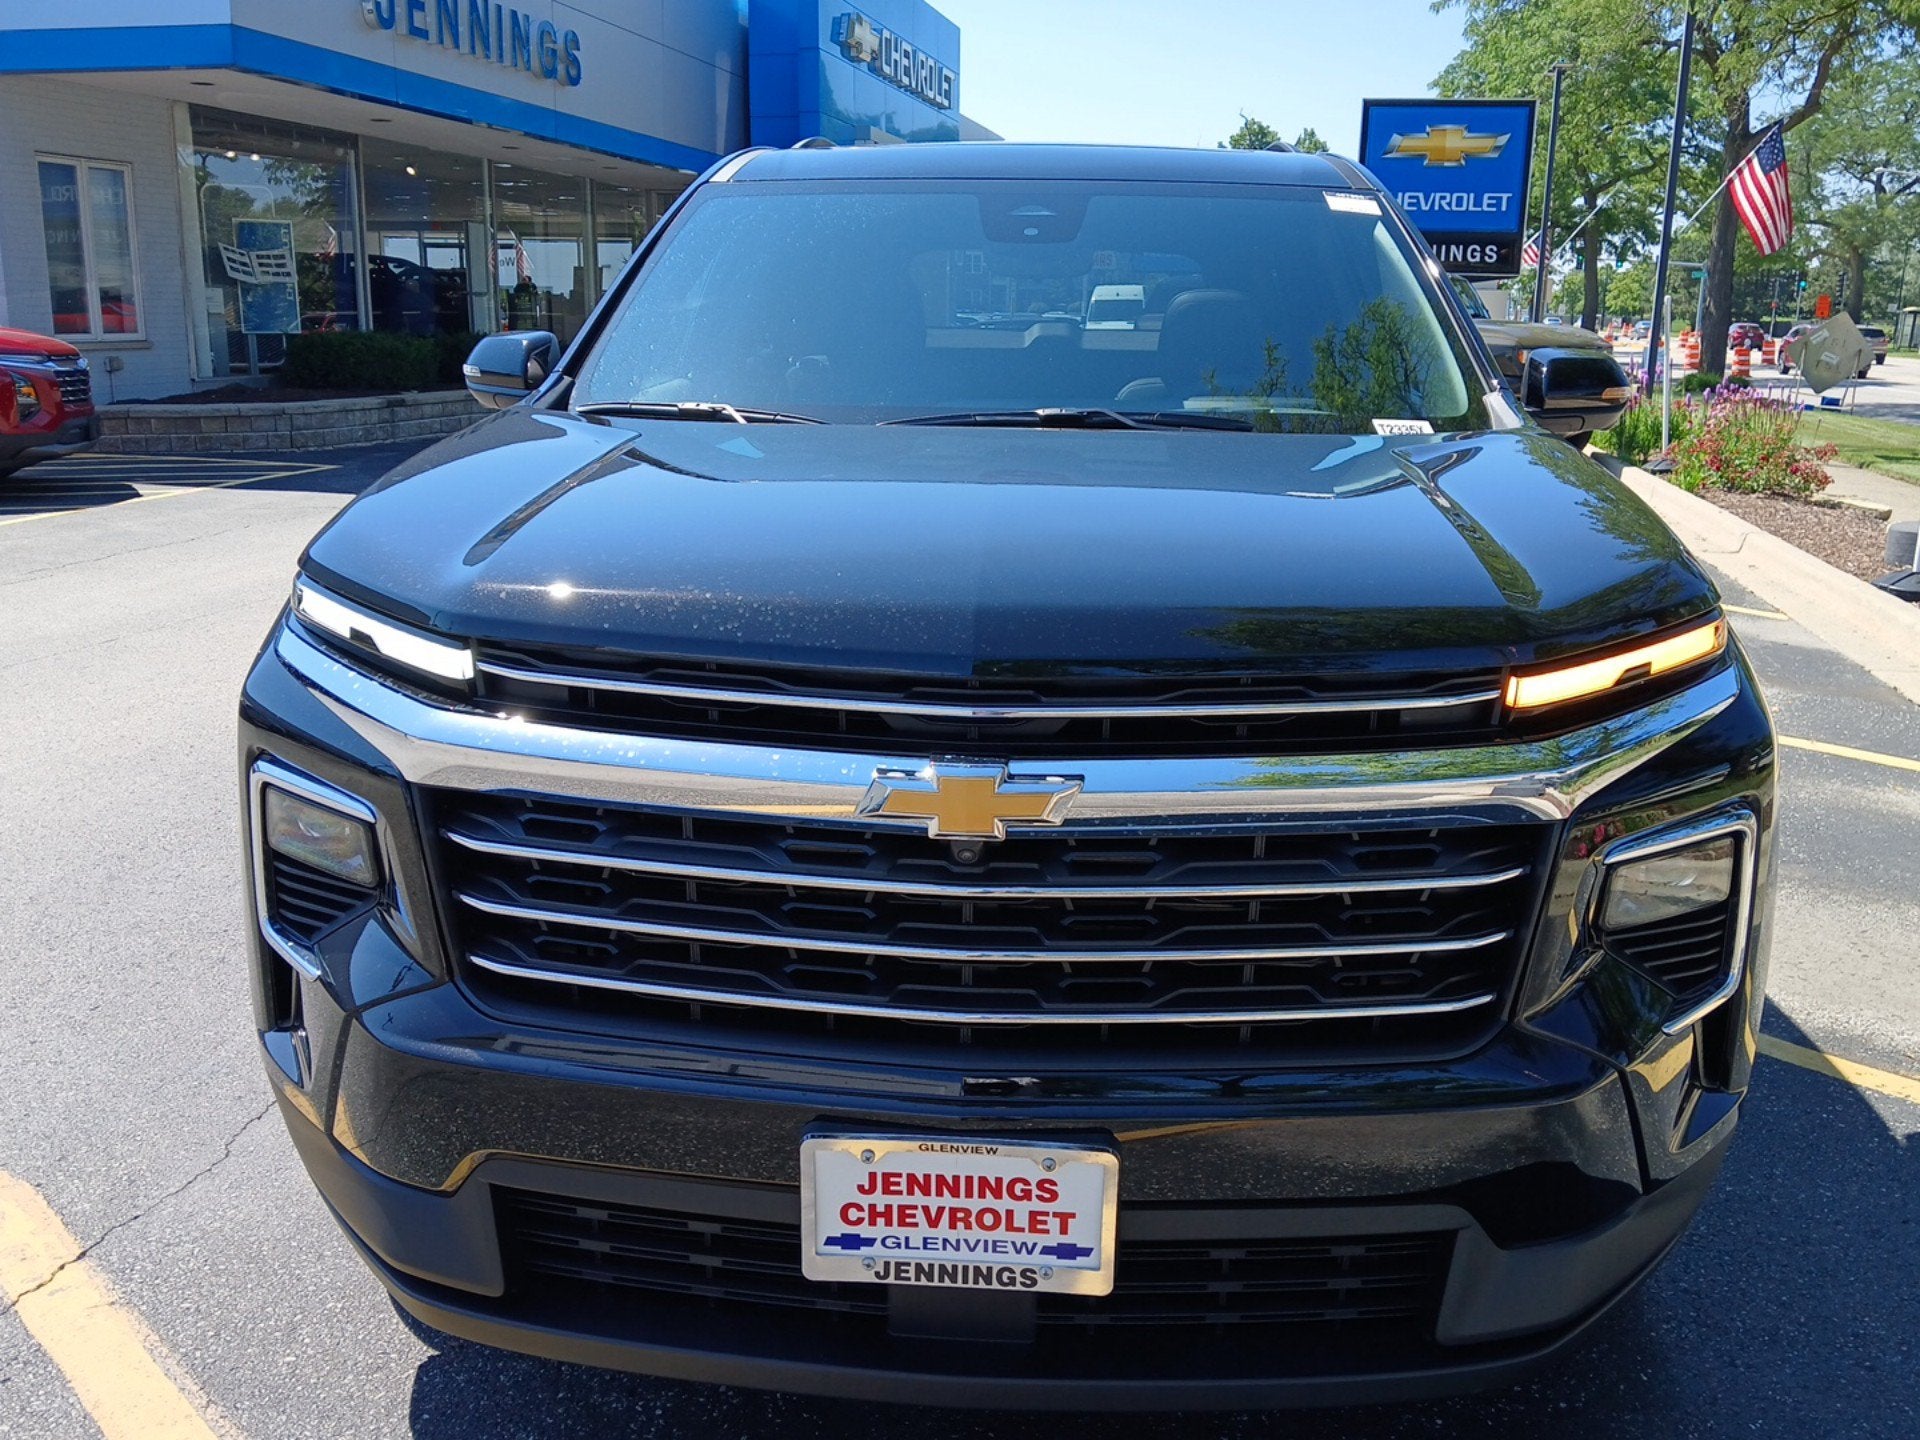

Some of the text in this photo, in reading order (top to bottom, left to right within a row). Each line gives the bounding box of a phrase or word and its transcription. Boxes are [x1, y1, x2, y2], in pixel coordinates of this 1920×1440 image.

[881, 28, 956, 108] CHEVROLET
[1396, 192, 1512, 211] EVROLET
[1432, 244, 1498, 263] INGS
[918, 1143, 999, 1156] GLENVIEW
[856, 1171, 1060, 1204] JENNINGS
[839, 1202, 1077, 1236] CHEVROLET
[880, 1235, 1039, 1256] GLENVIEW
[874, 1260, 1039, 1289] JENNINGS
